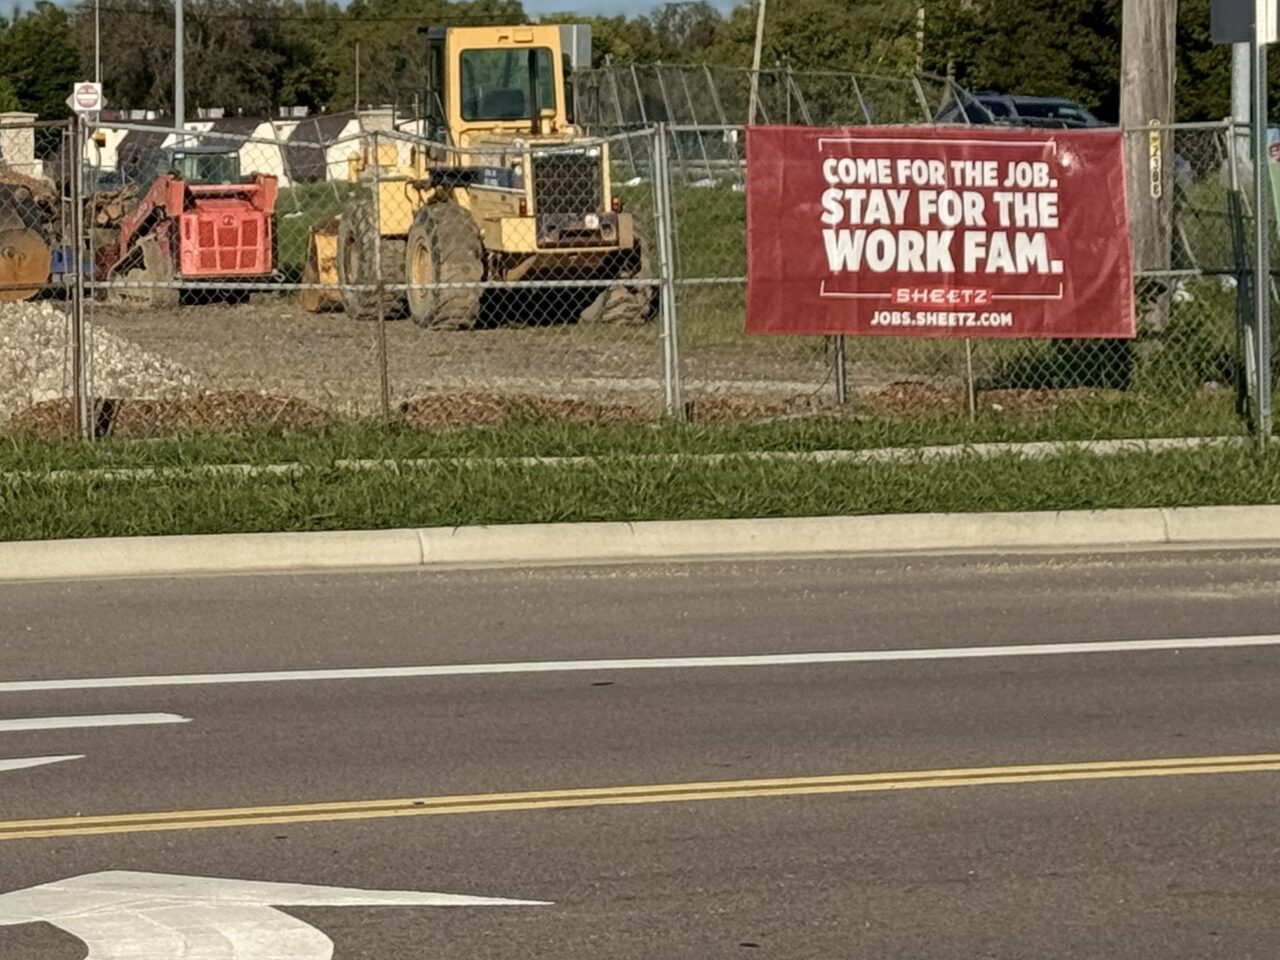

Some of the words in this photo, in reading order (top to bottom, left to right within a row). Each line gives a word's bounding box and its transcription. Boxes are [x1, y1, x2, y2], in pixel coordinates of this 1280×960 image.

[823, 158, 893, 185] COME
[897, 159, 946, 186] FOR
[951, 160, 999, 187] THE
[1003, 161, 1058, 188] JOB.
[821, 187, 911, 225] STAY
[919, 190, 987, 227] FOR
[993, 191, 1059, 228] THE
[822, 228, 956, 273] WORK
[964, 231, 1064, 275] FAM.
[896, 288, 988, 304] SHEETZ
[871, 311, 1014, 327] JOBS.SHEETZ.COM
